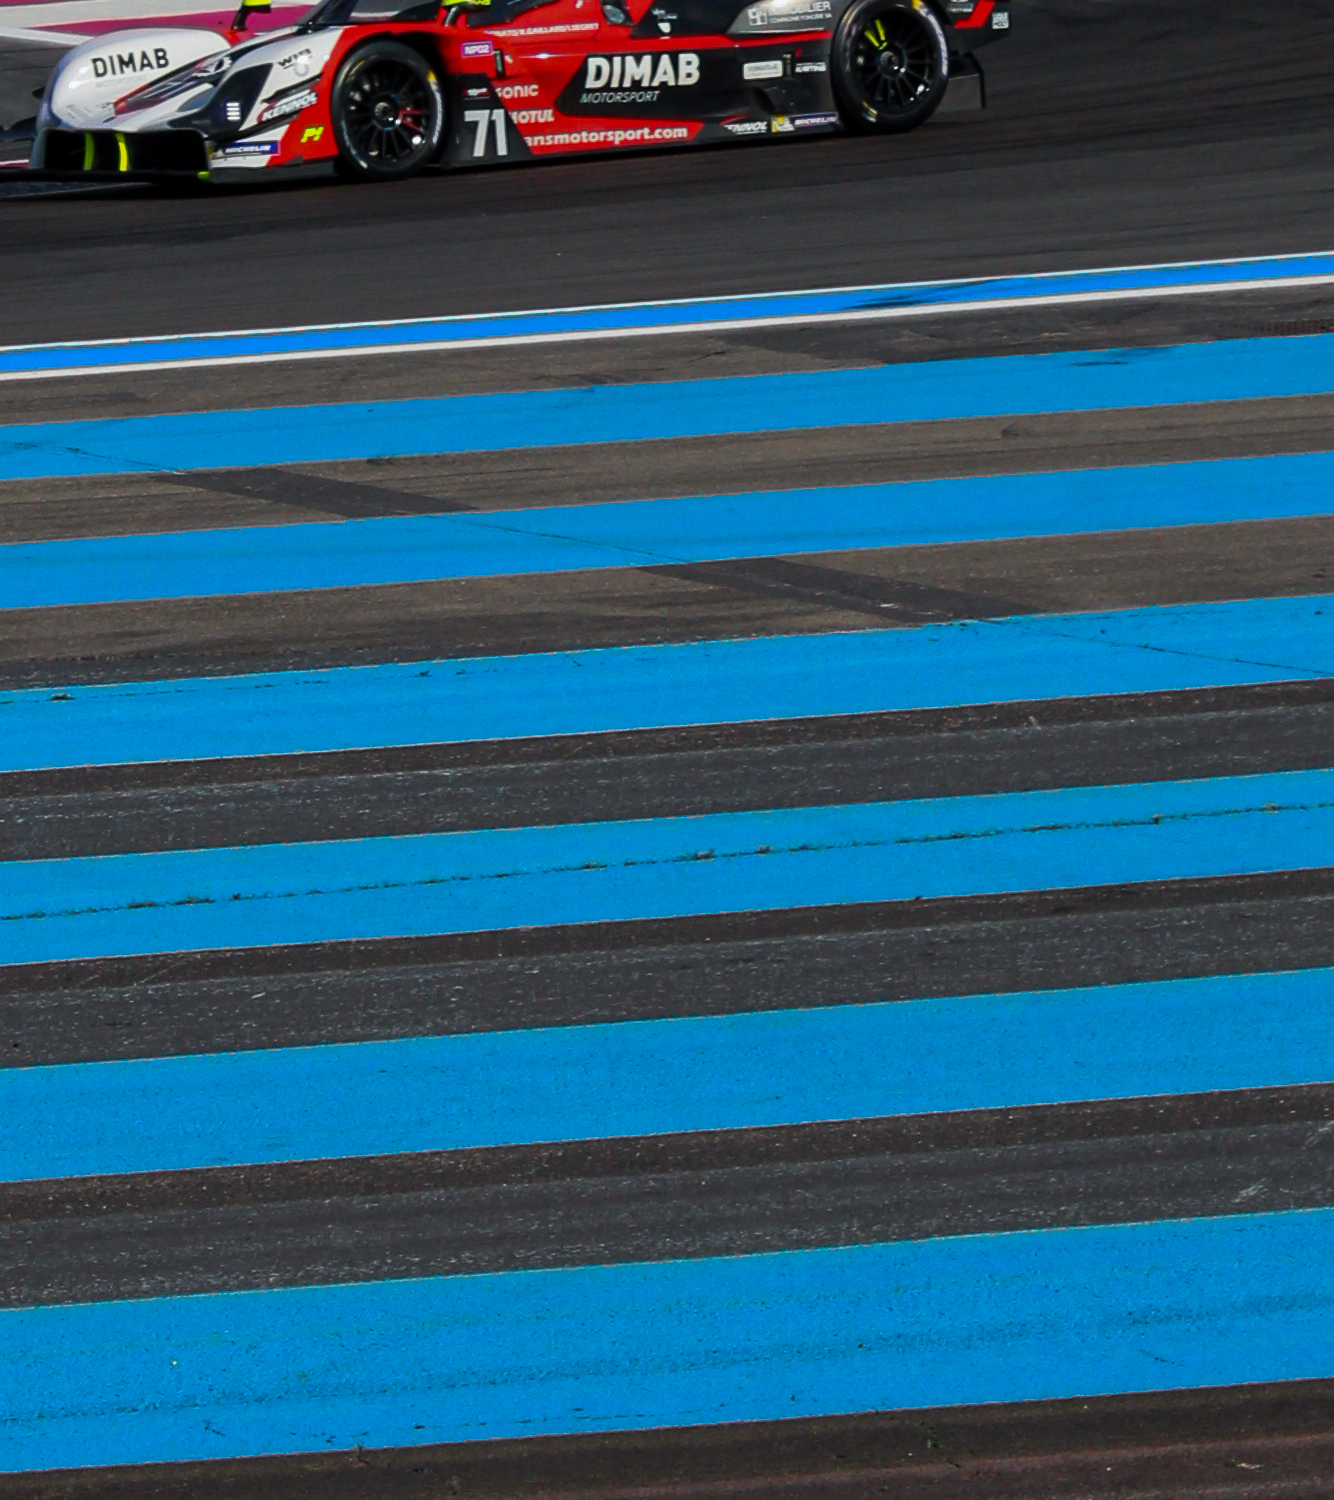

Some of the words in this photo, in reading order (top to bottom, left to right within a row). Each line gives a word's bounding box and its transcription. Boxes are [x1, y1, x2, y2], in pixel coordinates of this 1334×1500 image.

[91, 48, 169, 78] DIMAB
[584, 52, 701, 89] DIMAB
[579, 90, 661, 104] MOTORSPORT
[463, 108, 509, 158] 71
